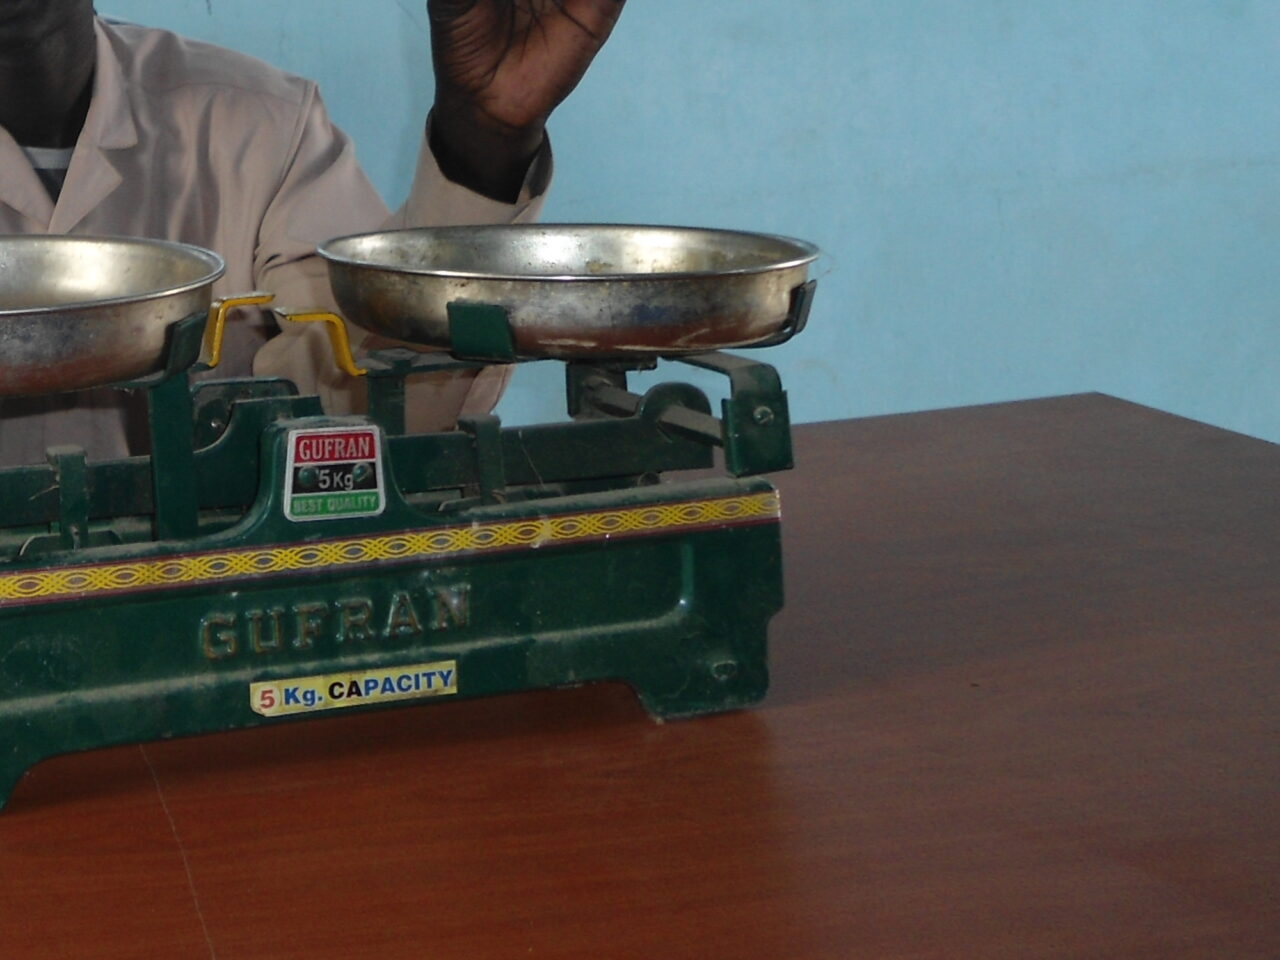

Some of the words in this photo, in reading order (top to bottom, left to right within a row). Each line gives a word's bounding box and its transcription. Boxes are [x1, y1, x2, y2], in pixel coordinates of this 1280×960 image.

[298, 436, 371, 460] GUFRAN
[318, 469, 331, 489] 5
[332, 471, 354, 491] Kg
[293, 498, 323, 514] BEST
[327, 495, 377, 511] QUALITY
[200, 583, 472, 660] GUFRAN
[259, 689, 276, 710] 5
[283, 686, 324, 707] Kg.
[327, 668, 454, 701] CAPACITY
